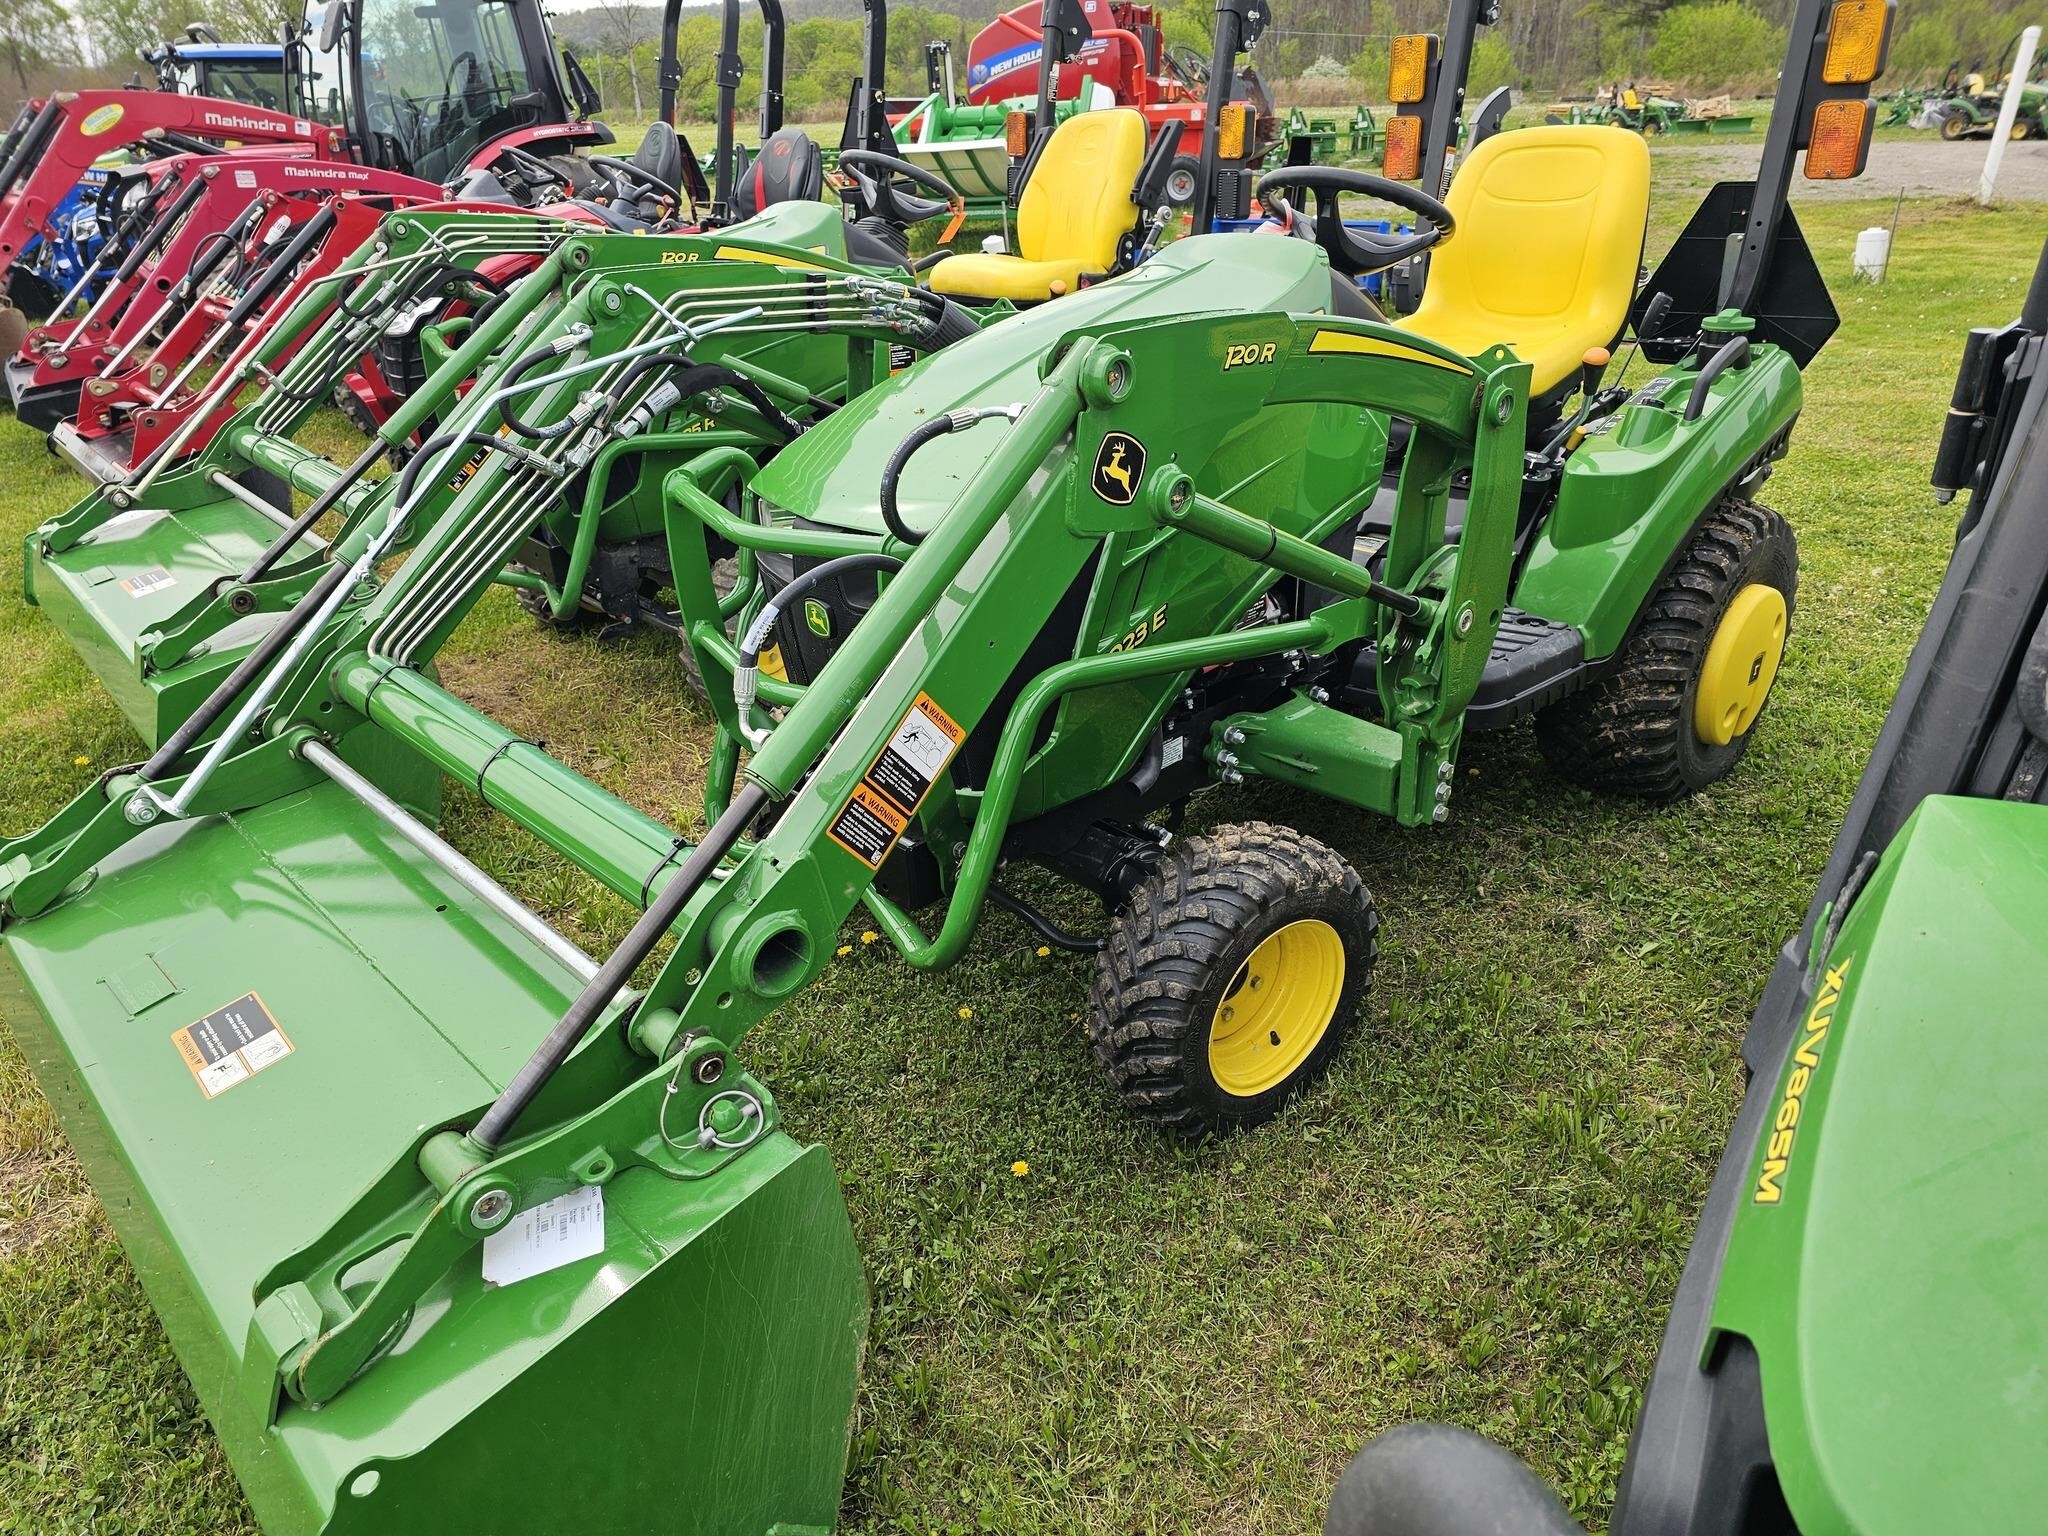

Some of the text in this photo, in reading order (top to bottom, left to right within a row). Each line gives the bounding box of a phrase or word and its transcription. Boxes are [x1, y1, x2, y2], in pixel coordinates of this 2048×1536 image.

[990, 47, 1043, 76] NEW HOLLA
[205, 112, 287, 133] Mahindra
[284, 166, 346, 179] Mahindra
[928, 705, 959, 738] WARNING
[867, 797, 900, 829] WARNING
[179, 1035, 199, 1061] WARNING
[1754, 957, 1852, 1203] XUV865M
